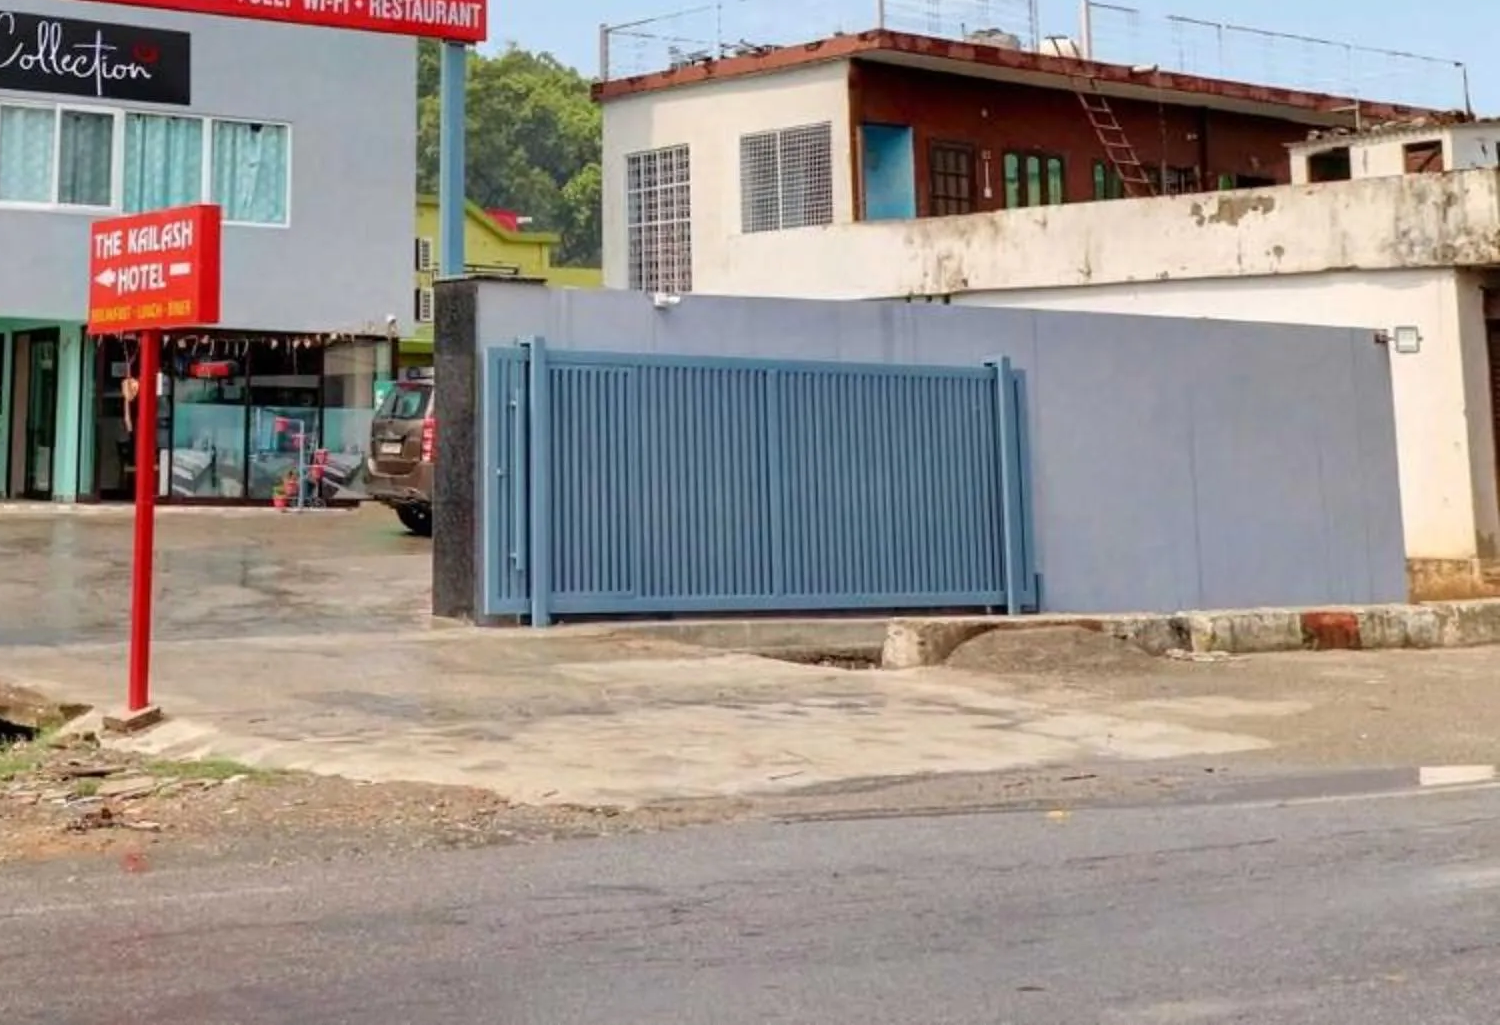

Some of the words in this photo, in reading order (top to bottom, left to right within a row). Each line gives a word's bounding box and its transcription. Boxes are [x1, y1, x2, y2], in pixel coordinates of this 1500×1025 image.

[95, 230, 123, 260] THE
[127, 219, 193, 255] KAILASH
[117, 262, 166, 295] HOTEL
